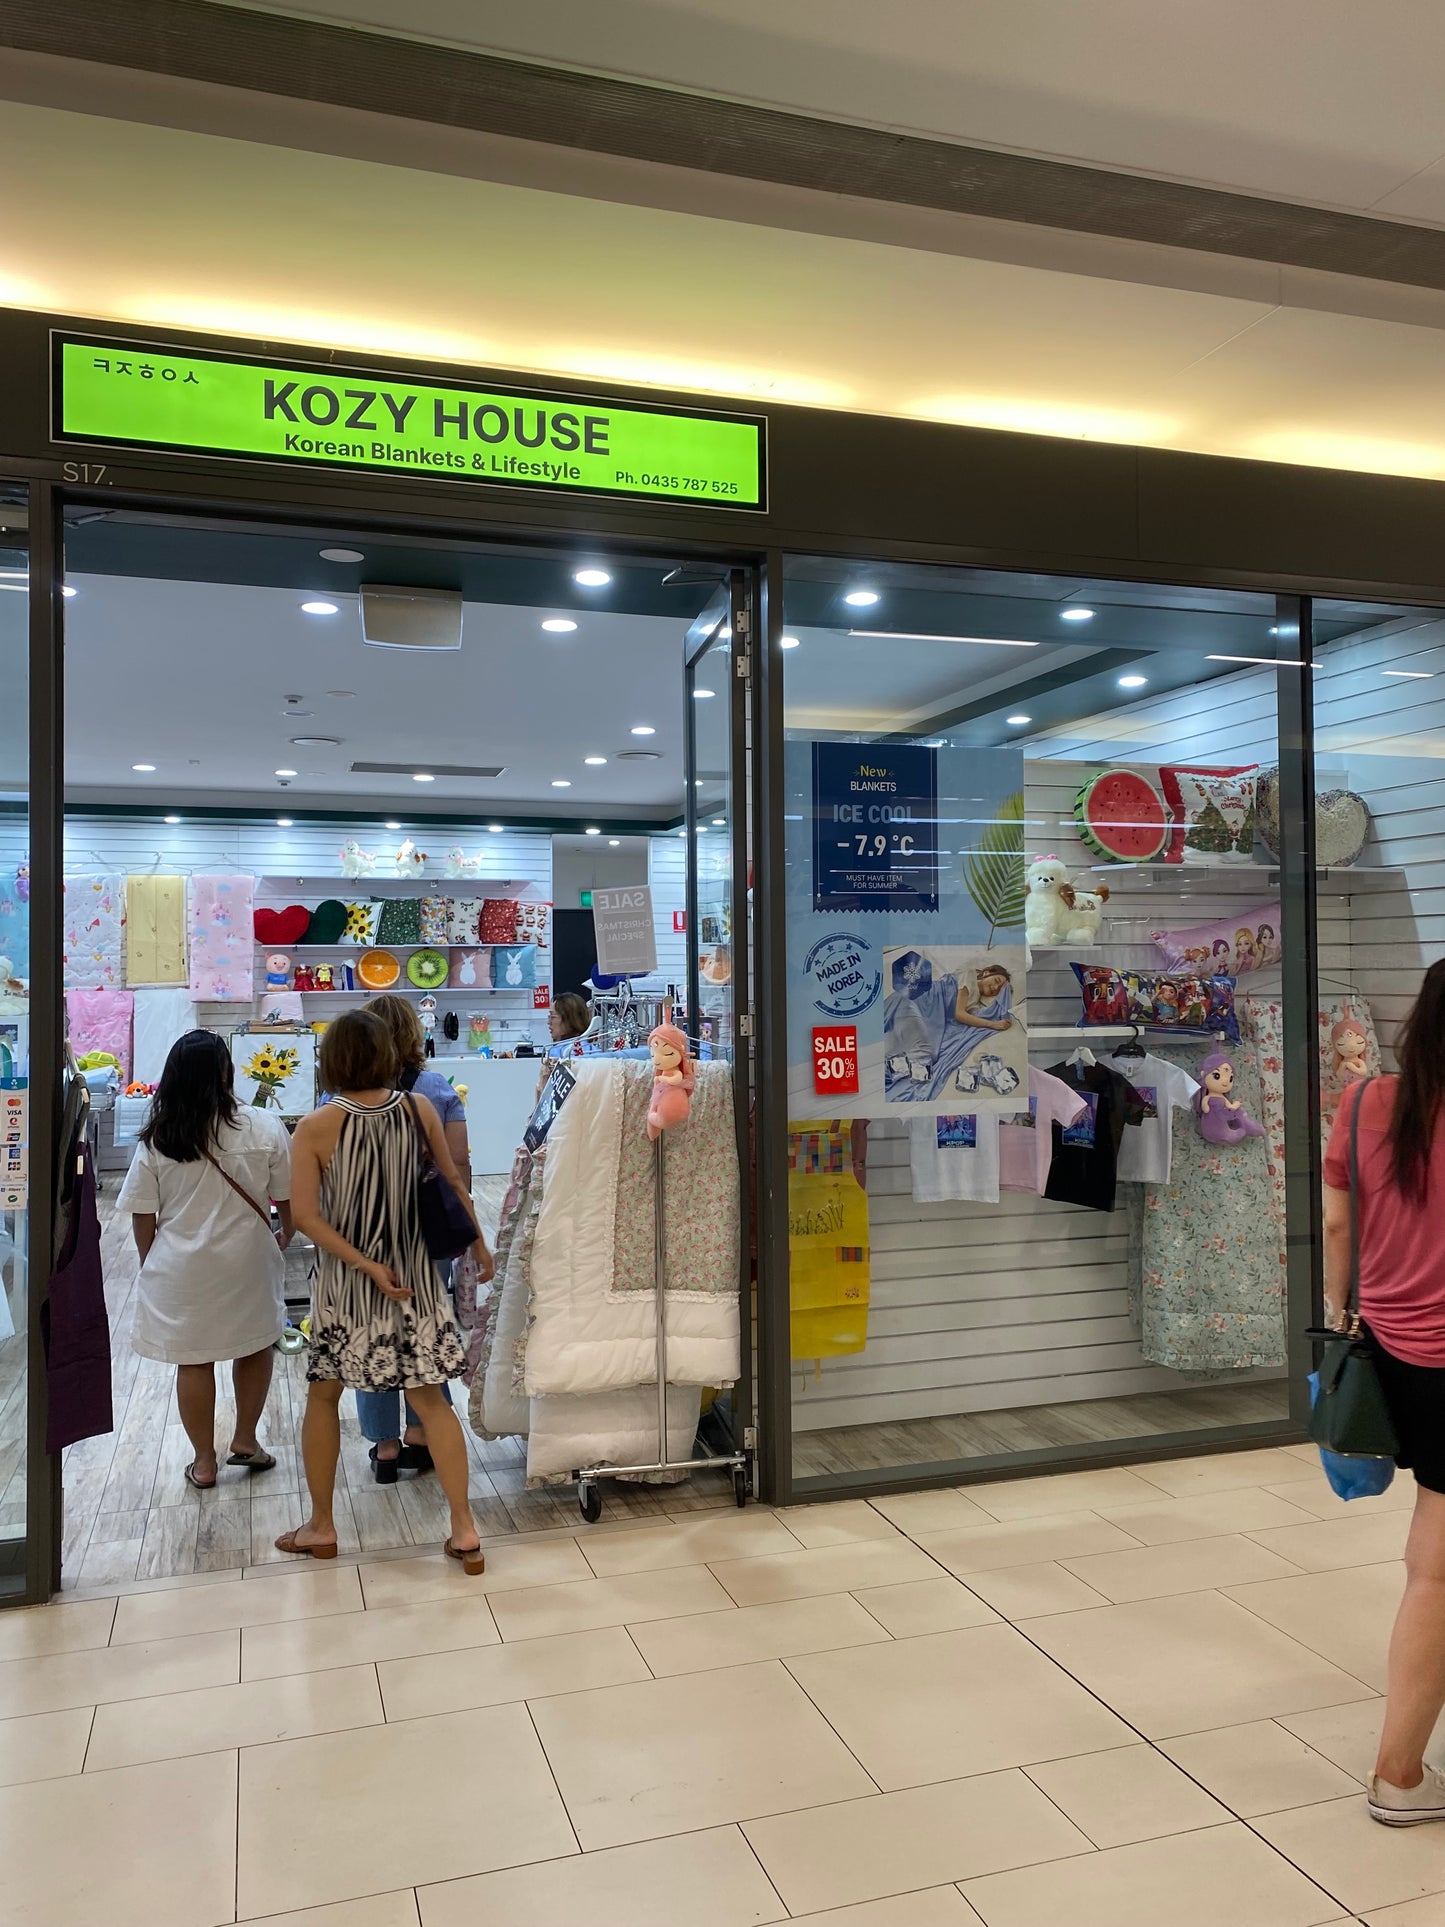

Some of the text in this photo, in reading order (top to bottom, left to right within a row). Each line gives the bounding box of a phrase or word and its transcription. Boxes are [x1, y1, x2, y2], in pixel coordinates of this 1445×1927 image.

[264, 379, 610, 456] KOZY HOUSE
[285, 433, 581, 481] Korean Blankets & Lifestyle
[615, 471, 738, 494] Ph. 0435 787 525
[860, 765, 887, 777] New
[850, 781, 897, 792] BLANKETS
[833, 804, 917, 824] ICE COOL
[816, 952, 862, 983] MADE IN
[827, 970, 864, 995] KOREA
[814, 1036, 855, 1053] SALE
[551, 1069, 571, 1099] SALE
[845, 1070, 855, 1078] OFF
